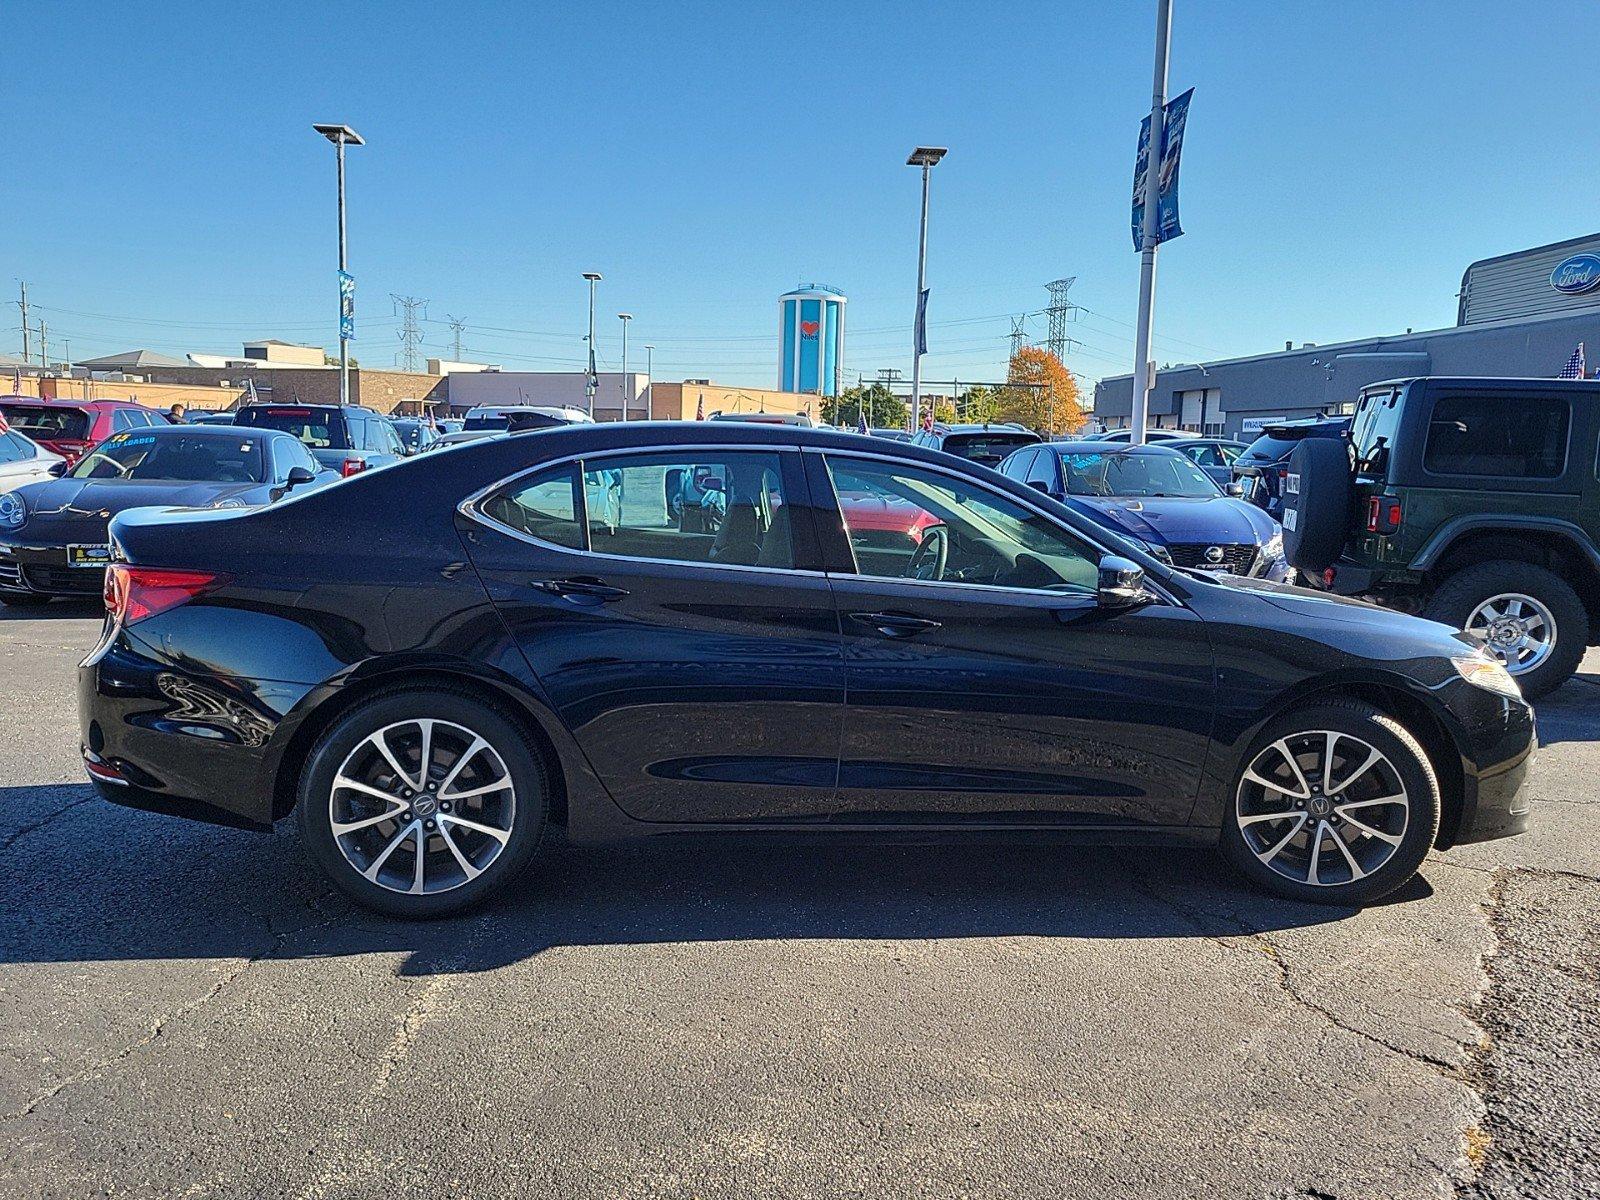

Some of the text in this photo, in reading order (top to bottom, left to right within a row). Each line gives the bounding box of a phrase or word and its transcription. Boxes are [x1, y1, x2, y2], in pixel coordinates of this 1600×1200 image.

[1558, 262, 1593, 287] Ford
[801, 332, 819, 341] Niles
[123, 437, 156, 446] LOADED
